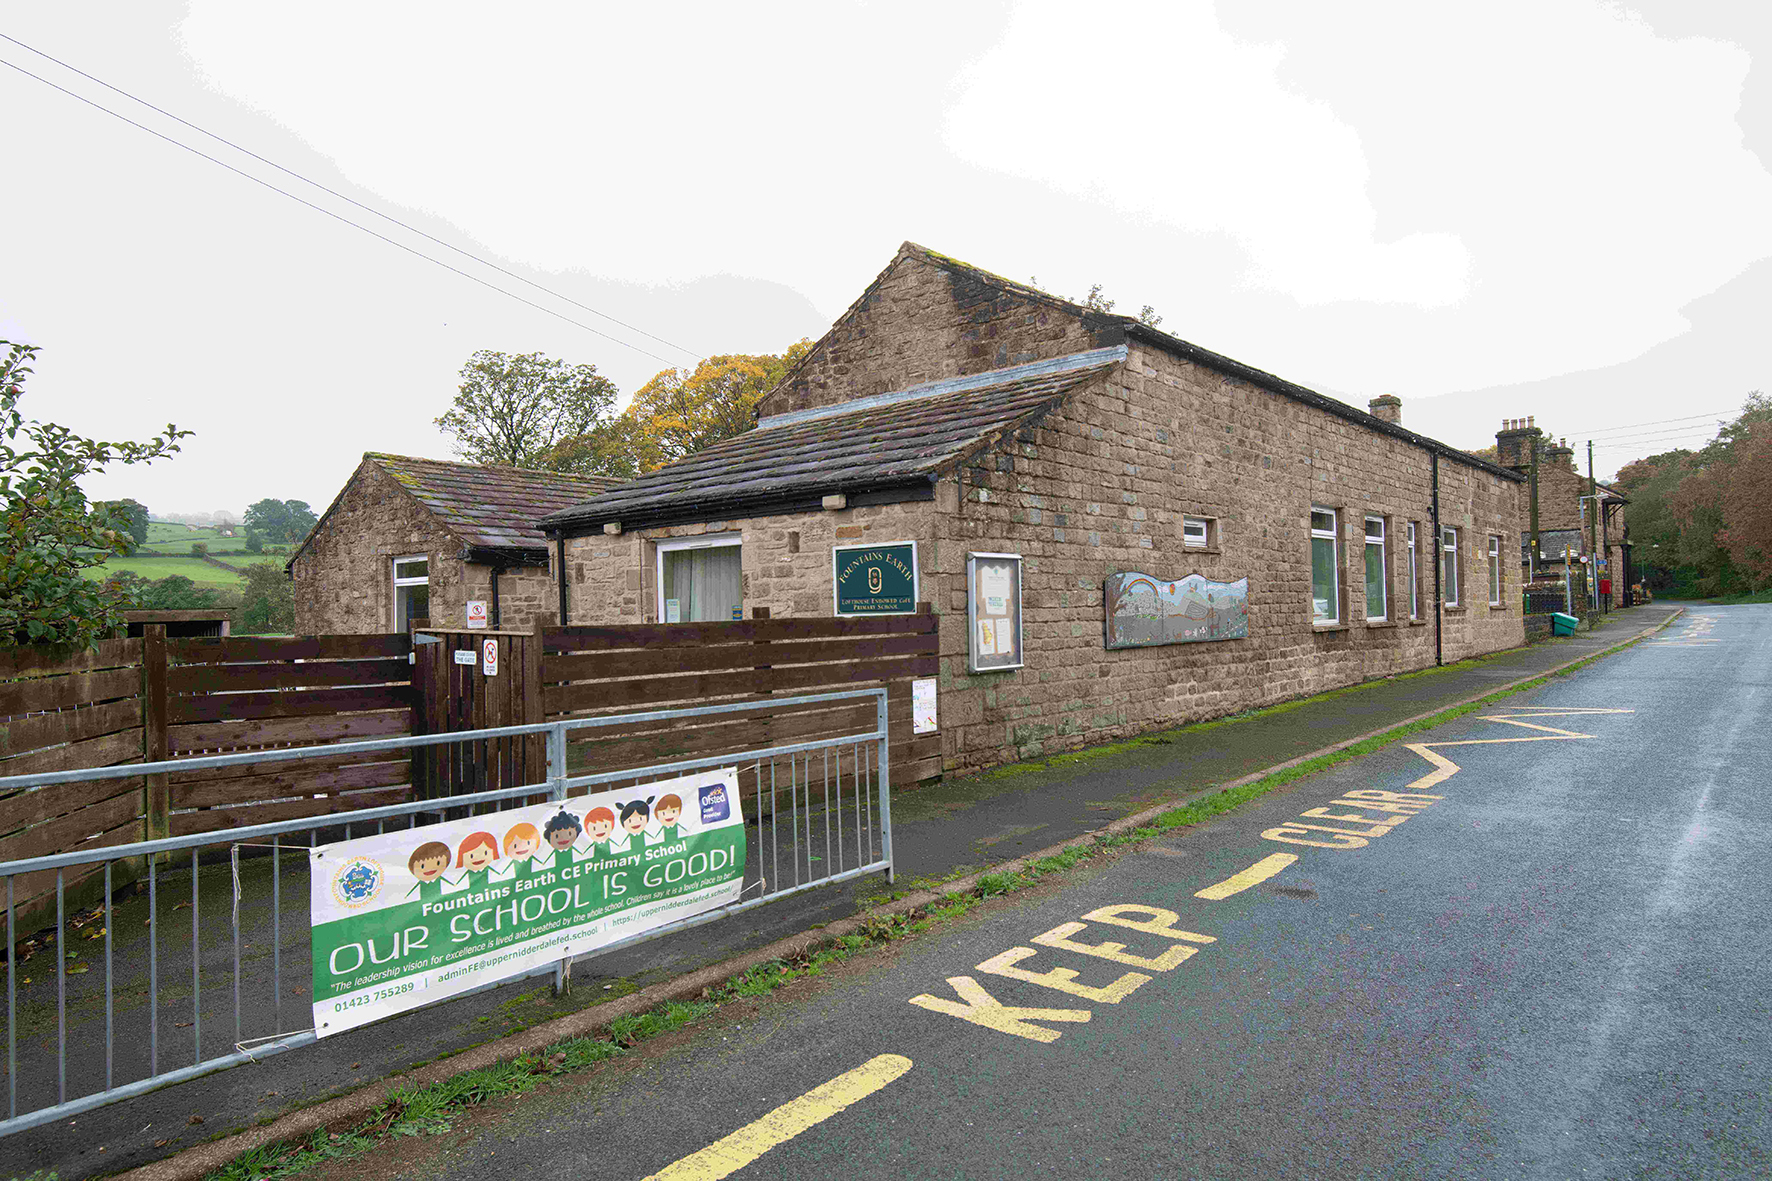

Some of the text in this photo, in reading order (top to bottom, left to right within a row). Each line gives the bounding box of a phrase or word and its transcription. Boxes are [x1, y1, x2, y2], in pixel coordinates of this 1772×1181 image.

[839, 552, 912, 583] FOUNTAINS EARTH
[702, 792, 726, 806] Ofsted
[330, 845, 735, 975] OUR SCHOOL IS GOOD!
[354, 966, 400, 986] leadership
[403, 959, 428, 972] vision
[431, 954, 444, 965] for
[445, 943, 486, 960] excellence
[487, 940, 494, 949] is
[496, 934, 514, 946] lived
[515, 927, 530, 939] and
[531, 919, 561, 935] breathed
[562, 916, 572, 926] by
[573, 912, 586, 922] the
[587, 907, 604, 919] whole
[604, 900, 624, 913] school.
[626, 893, 651, 906] Children
[653, 890, 665, 899] say
[683, 880, 699, 891] lovely
[700, 876, 716, 888] place
[422, 841, 687, 916] Fountains Earth CE Primary School
[908, 789, 1444, 1044] KEEP CLEAR
[334, 885, 734, 1012] 01423 755289 adminFE@uppernidderdalefed.school https://uppernidderdalefed.school/
